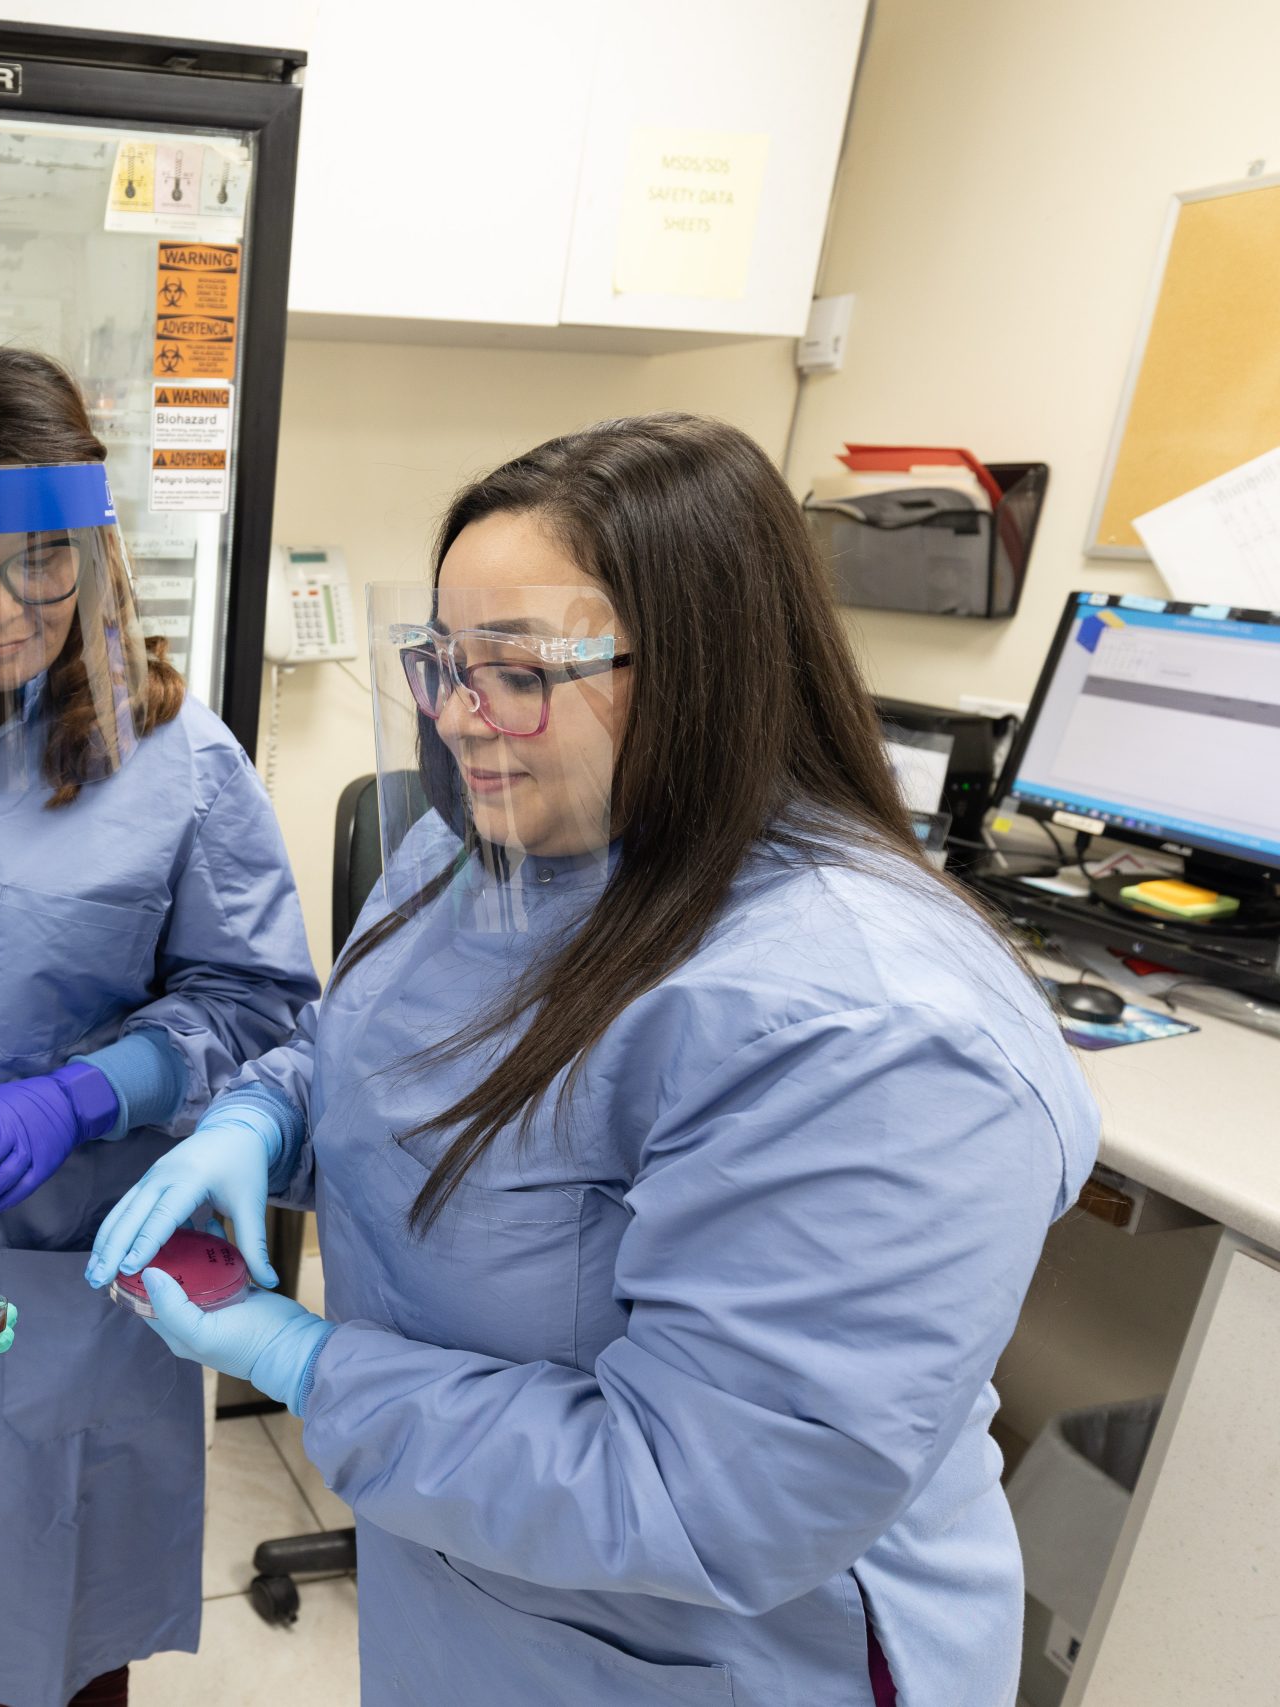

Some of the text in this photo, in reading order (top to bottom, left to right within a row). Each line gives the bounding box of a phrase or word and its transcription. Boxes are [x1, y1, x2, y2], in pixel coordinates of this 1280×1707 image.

[648, 186, 735, 206] SAFETY DATA
[663, 216, 712, 233] SHEETS
[164, 249, 233, 267] WARNING
[162, 320, 228, 336] ADVERTENCIA
[172, 389, 229, 404] WARNING
[156, 412, 217, 425] Biohazard
[170, 452, 226, 466] ADVERTENCIA
